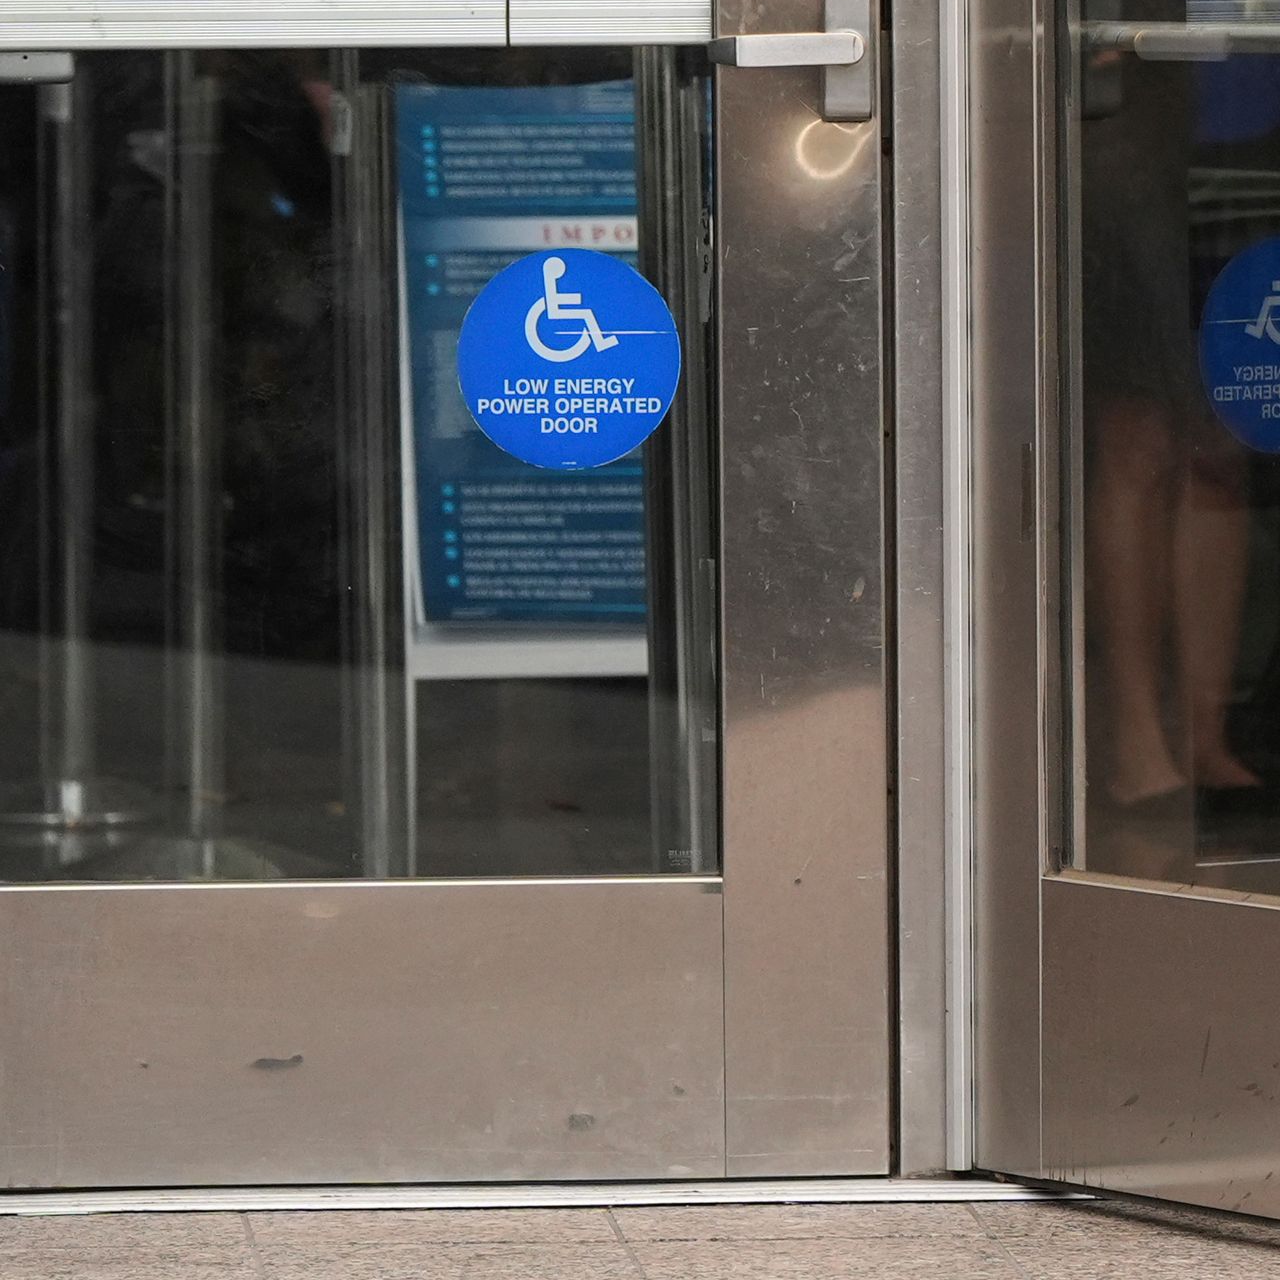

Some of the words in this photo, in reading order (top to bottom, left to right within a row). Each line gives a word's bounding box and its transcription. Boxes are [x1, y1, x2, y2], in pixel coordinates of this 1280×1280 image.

[504, 379, 549, 395] LOW
[554, 378, 635, 394] ENERGY
[478, 398, 549, 414] POWER
[555, 398, 661, 414] OPERATED
[541, 417, 598, 433] DOOR
